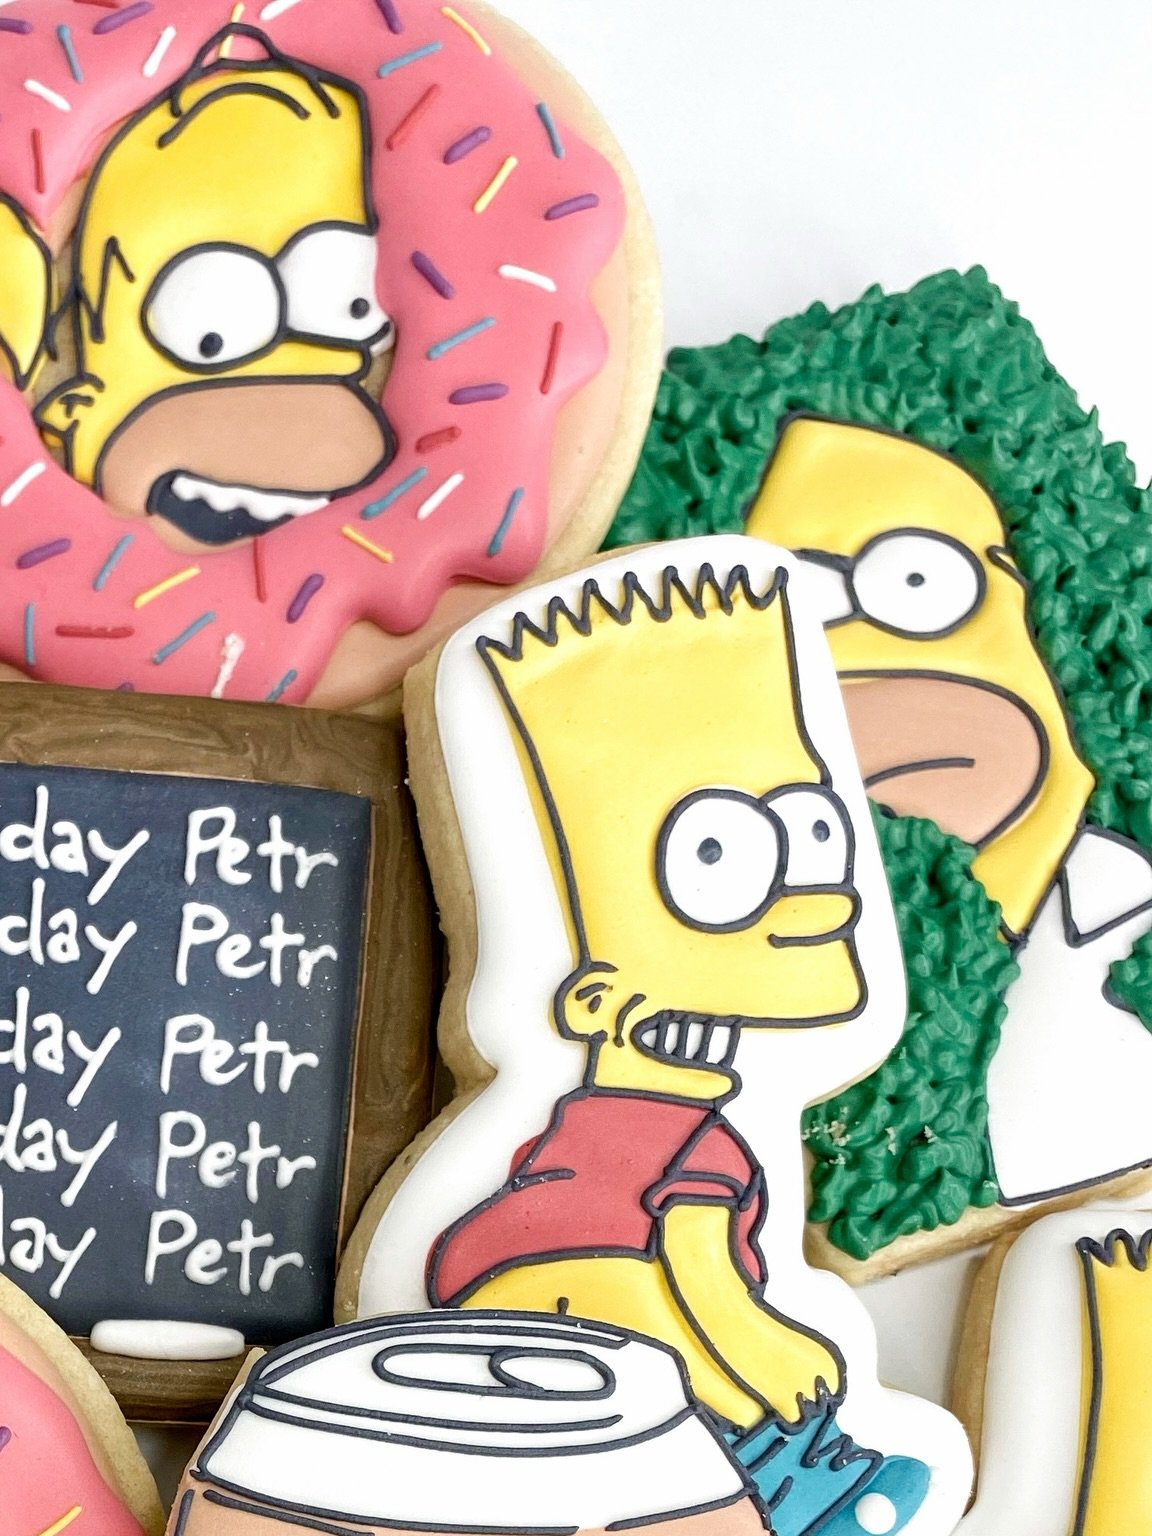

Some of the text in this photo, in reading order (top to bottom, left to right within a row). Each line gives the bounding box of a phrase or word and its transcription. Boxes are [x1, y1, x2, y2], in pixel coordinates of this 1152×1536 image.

[184, 806, 339, 893] Petr
[176, 902, 338, 988] Petr
[160, 1014, 319, 1095] Petr
[156, 1110, 318, 1203] Petr
[144, 1208, 304, 1296] Petr
